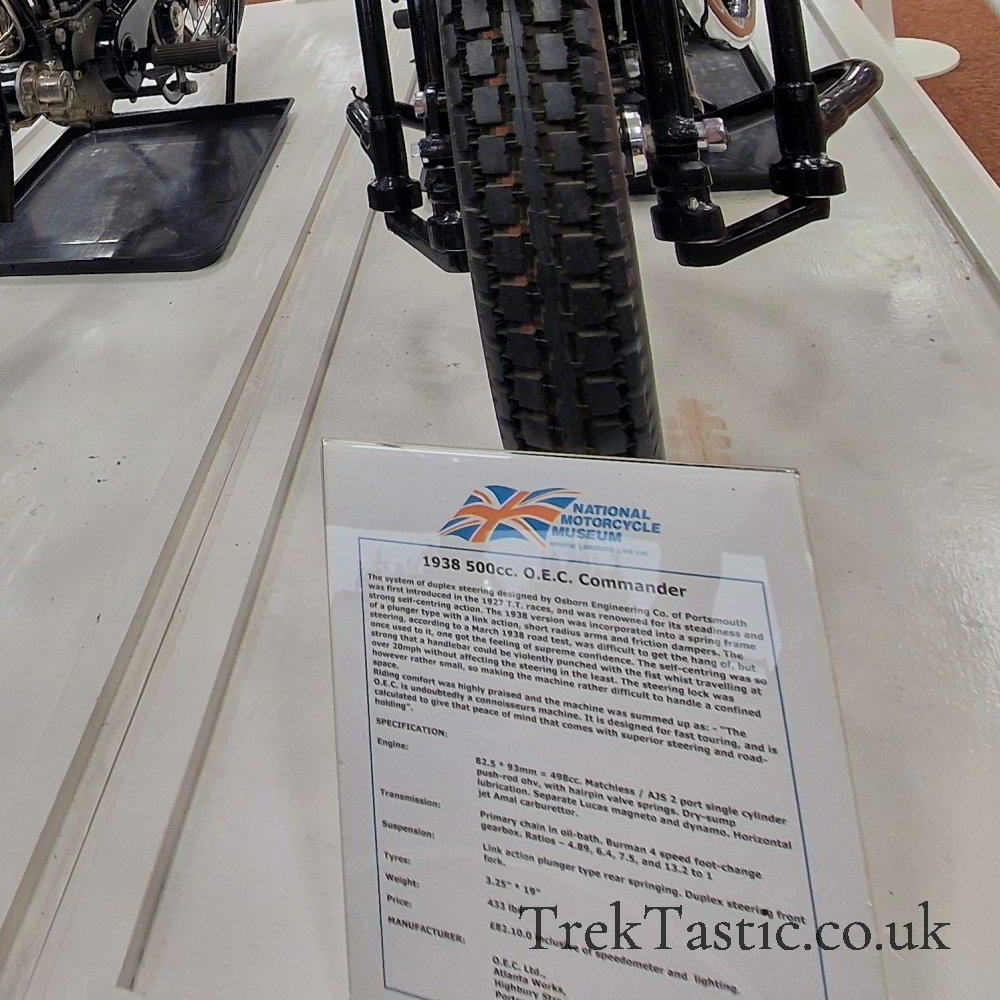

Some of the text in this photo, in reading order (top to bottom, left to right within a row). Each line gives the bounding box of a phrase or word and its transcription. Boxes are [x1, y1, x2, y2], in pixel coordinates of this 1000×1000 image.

[552, 526, 622, 542] MUSEUM
[561, 514, 661, 534] MOTORCYCLE
[573, 503, 651, 520] NATIONAL
[368, 573, 383, 581] The
[385, 577, 415, 585] system
[417, 579, 425, 587] of
[427, 580, 456, 591] duplex
[459, 585, 495, 597] steering
[496, 589, 538, 601] designed
[540, 595, 552, 604] by
[554, 596, 589, 607] Osborn
[591, 601, 651, 617] Engineering
[652, 609, 669, 617] Co.
[685, 613, 747, 627] Portsmouth
[422, 554, 687, 598] 1938 500cc. O.E.C. Commander
[369, 592, 396, 603] strong
[398, 596, 452, 611] self-centring
[454, 604, 485, 613] action.
[485, 607, 504, 616] The
[504, 609, 529, 619] 1938
[529, 615, 565, 624] version
[589, 621, 653, 636] incorporated
[656, 630, 677, 639] into
[688, 636, 722, 647] spring
[723, 639, 756, 650] frame
[387, 584, 404, 593] first
[406, 587, 452, 599] introduced
[464, 595, 481, 603] the
[481, 596, 504, 606] 1927
[506, 600, 525, 609] T.T.
[526, 604, 556, 614] races,
[599, 614, 649, 625] renowned
[650, 619, 667, 627] for
[668, 621, 682, 629] its
[685, 625, 741, 637] steadiness
[372, 649, 408, 661] however
[411, 656, 437, 665] rather
[440, 661, 466, 671] small,
[481, 668, 515, 679] making
[517, 672, 532, 680] the
[535, 676, 575, 687] machine
[578, 683, 608, 692] rather
[611, 687, 650, 699] difficult
[666, 696, 703, 707] handle
[714, 705, 762, 717] confined
[376, 717, 447, 737] SPECIFICATION:
[377, 737, 409, 751] Engine:
[380, 788, 441, 808] Transmission:
[476, 757, 496, 767] 82.5
[507, 763, 537, 775] 93mm
[551, 772, 582, 784] 498cc.
[585, 779, 636, 795] Matchless
[648, 791, 667, 801] AJS
[680, 799, 703, 808] port
[706, 803, 739, 815] single
[742, 811, 787, 824] cylinder
[477, 770, 737, 829] push-rod ohv, with hairpin valve springs. Dry-sump
[478, 778, 792, 850] lubrication. Separate Lucas magneto and dynamo. Horizontal
[382, 820, 435, 839] Suspension:
[480, 810, 762, 879] Primary chain in oil-bath. Burman 4 speed foot-change
[481, 824, 523, 837] gearbox.
[525, 832, 556, 844] Ratios
[642, 859, 662, 868] and
[665, 863, 689, 874] 13.2
[691, 869, 704, 877] to
[386, 873, 420, 888] Weight:
[483, 843, 503, 854] Link
[506, 850, 535, 862] action
[538, 858, 576, 872] plunger
[579, 867, 602, 878] type
[604, 874, 625, 883] rear
[629, 879, 682, 897] springing.
[685, 891, 724, 905] Duplex
[777, 911, 807, 924] front
[388, 916, 466, 943] MANUFACTURER:
